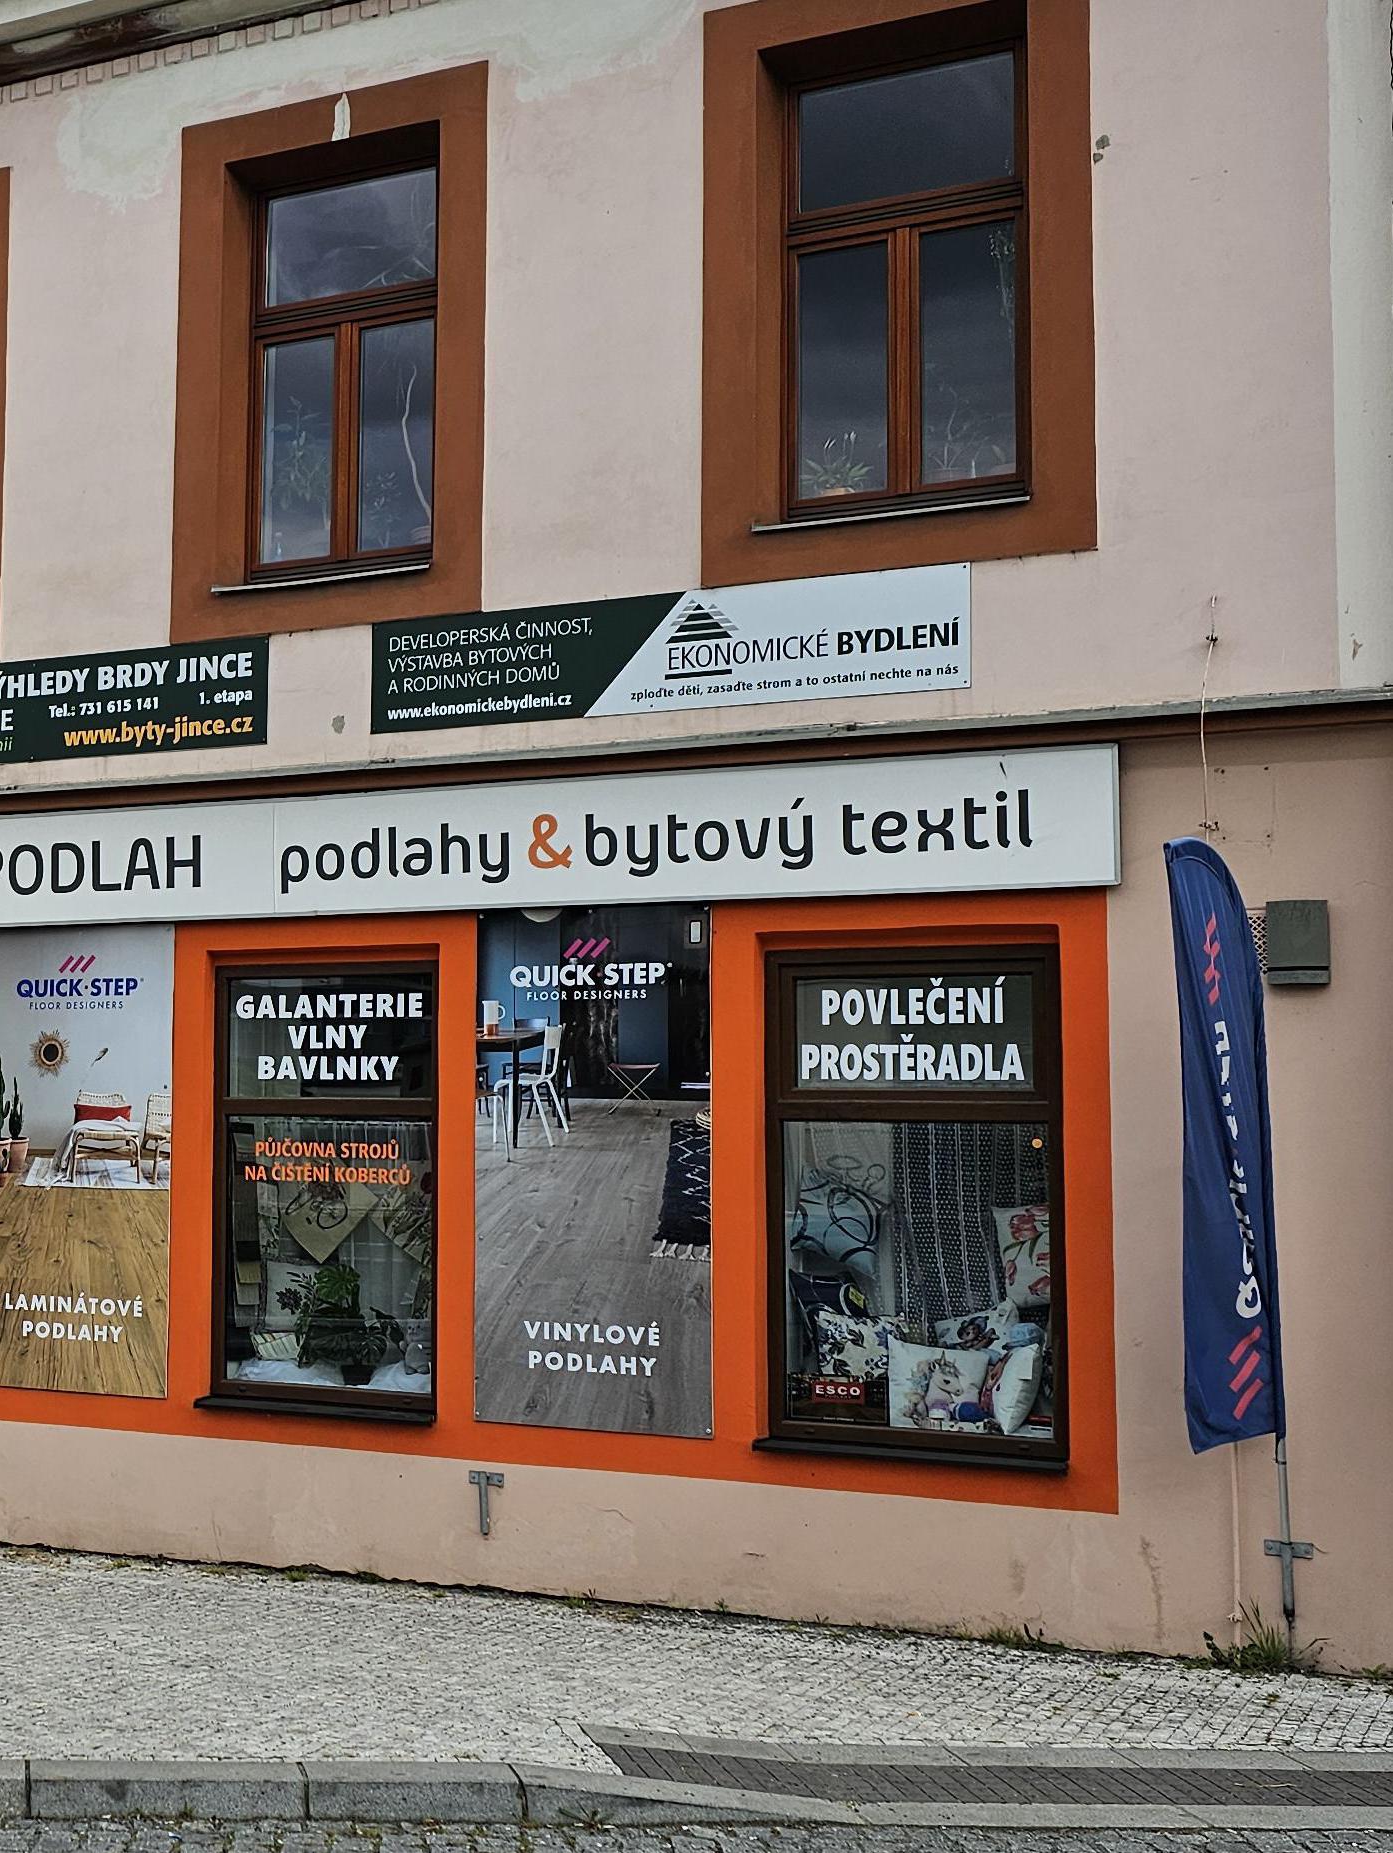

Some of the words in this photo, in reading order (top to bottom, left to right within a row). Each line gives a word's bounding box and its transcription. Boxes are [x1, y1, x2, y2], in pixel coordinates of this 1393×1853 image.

[389, 623, 511, 652] DEVELOPERSKÁ
[515, 617, 593, 640] ČINNOST,
[668, 628, 829, 670] EKONOMICKÉ
[837, 616, 960, 656] BYDLENÍ
[97, 659, 169, 691] BRDY
[176, 652, 253, 684] JINCE
[388, 654, 464, 673] VÝSTAVBA
[468, 643, 552, 666] BYTOVÝCH
[388, 679, 398, 695] A
[403, 668, 500, 693] RODINNÝCH
[506, 661, 560, 684] DOMŮ
[630, 687, 674, 703] zploďte
[678, 684, 703, 697] děti,
[707, 681, 753, 694] zasaďte
[757, 678, 791, 690] strom
[795, 678, 802, 687] a
[806, 676, 819, 686] to
[823, 671, 866, 684] ostatní
[870, 668, 912, 681] nechte
[916, 668, 932, 677] na
[936, 664, 959, 676] nás
[48, 703, 76, 718] Tel.:
[79, 702, 102, 716] 731
[107, 699, 131, 713] 615
[136, 696, 159, 711] 141
[199, 691, 210, 705] 1.
[213, 689, 253, 705] etapa
[387, 692, 573, 720] www.ekonomickebydleni.cz
[64, 716, 254, 748] www.byty-jince.cz
[281, 823, 510, 893] podlahy
[528, 813, 573, 869] &
[584, 797, 814, 877] bytový
[842, 788, 1034, 855] textil
[29, 1002, 61, 1010] FLOOR
[66, 1000, 124, 1010] DESIGNERS
[235, 992, 423, 1019] GALANTERIE
[527, 991, 567, 1001] FLOOR
[574, 989, 647, 1000] DESIGNERS
[820, 976, 1006, 1026] POVLEČENÍ
[287, 1023, 368, 1050] VLNY
[256, 1055, 399, 1080] BAVLNKY
[801, 1033, 1025, 1081] PROSTĚRADLA
[255, 1137, 336, 1158] PŮJČOVNA
[340, 1139, 400, 1160] STROJŮ
[244, 1165, 266, 1181] NA
[271, 1159, 330, 1182] ČIŠTĚNÍ
[334, 1162, 411, 1185] KOBERCŮ
[4, 1291, 144, 1318] LAMINÁTOVÉ
[22, 1319, 124, 1343] PODLAHY
[523, 1320, 660, 1347] VINYLOVÉ
[528, 1350, 657, 1376] PODLAHY
[815, 1384, 860, 1396] ESCO
